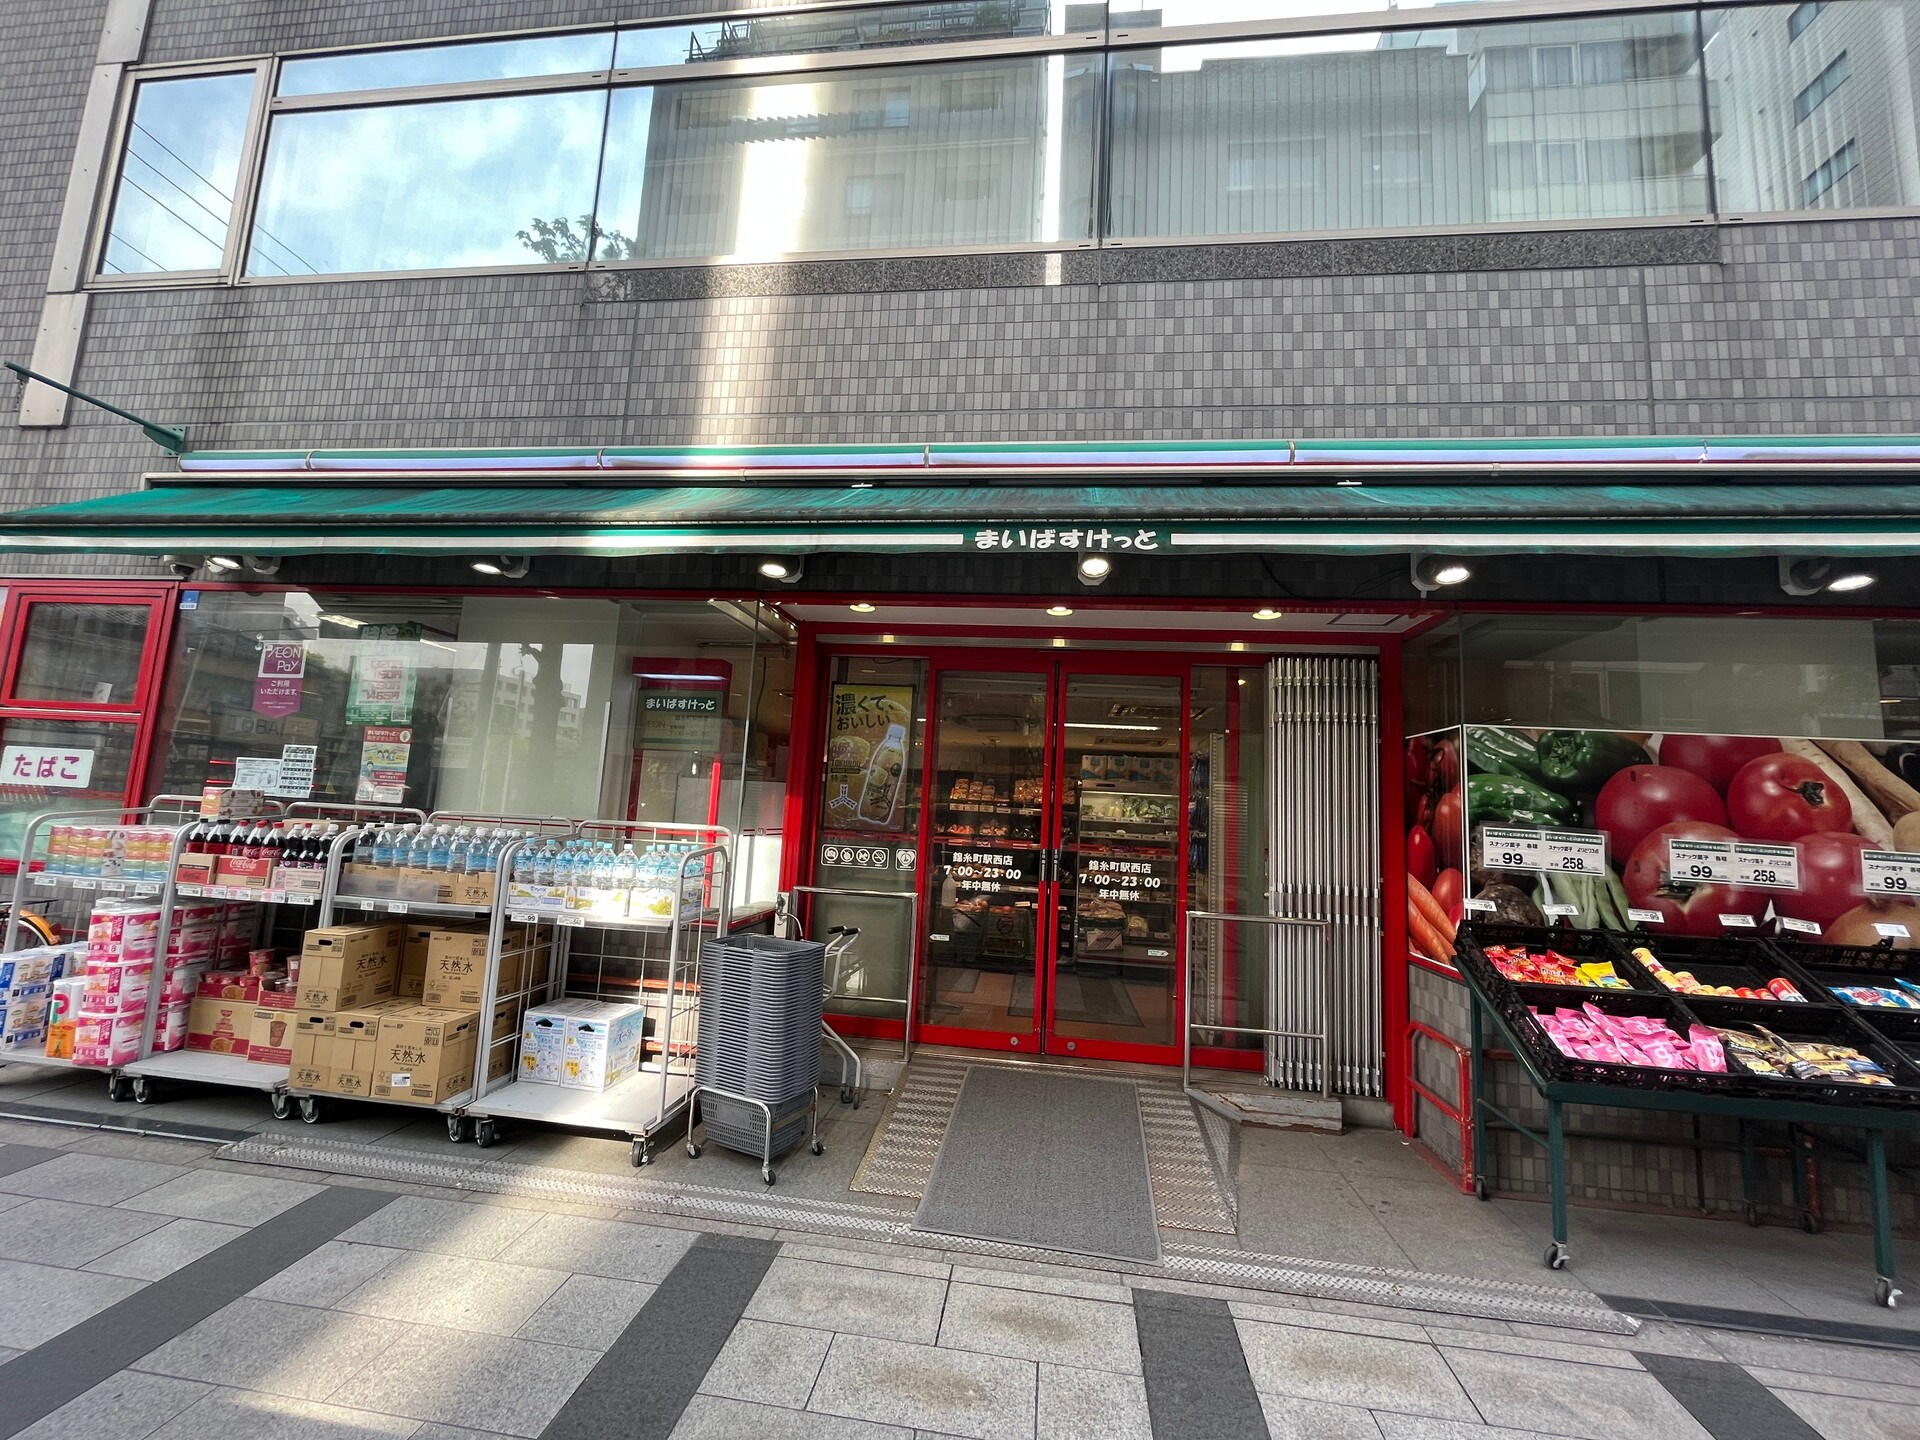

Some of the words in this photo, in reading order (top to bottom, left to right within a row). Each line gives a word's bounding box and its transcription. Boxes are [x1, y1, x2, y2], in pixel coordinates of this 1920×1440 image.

[974, 529, 1159, 550] まいばすけっと
[276, 660, 300, 672] Pay
[646, 698, 715, 711] まいばすけっと
[835, 693, 895, 716] 濃くて、
[836, 713, 891, 731] おいしい
[12, 754, 80, 780] たばこ
[952, 852, 1013, 866] 錦糸町駅西店
[1502, 852, 1524, 865] 99
[1562, 856, 1584, 870] 258
[1088, 860, 1152, 874] 錦糸町駅西店
[1690, 865, 1713, 878] 99
[1753, 869, 1776, 883] 258
[1884, 876, 1907, 890] 99
[961, 880, 1001, 892] 年中無休
[1099, 888, 1140, 901] 年中無休
[355, 954, 388, 971] 天然水
[440, 959, 473, 973] 天然水
[304, 992, 329, 1002] 天然水
[390, 1048, 426, 1064] 天然水
[296, 1071, 321, 1083] 天然水
[337, 1076, 362, 1088] 天然水
